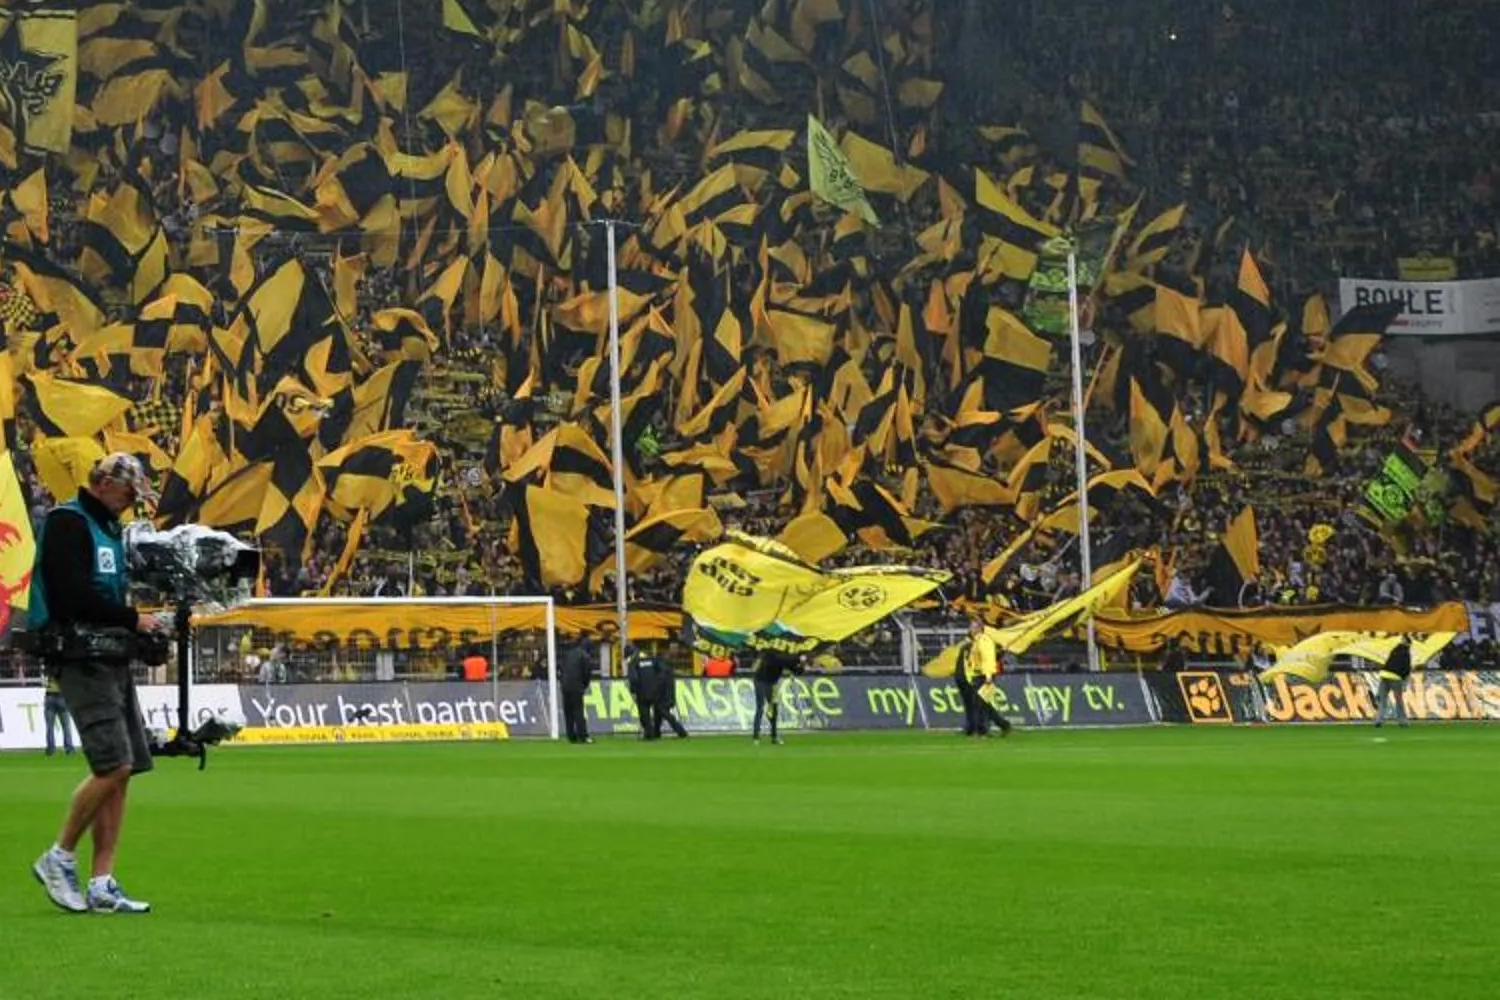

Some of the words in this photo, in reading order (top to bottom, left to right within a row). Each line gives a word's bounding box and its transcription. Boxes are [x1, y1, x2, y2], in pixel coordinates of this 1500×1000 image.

[252, 698, 327, 728] Your
[337, 694, 411, 727] best
[417, 691, 536, 724] partner.
[867, 688, 916, 725] my
[929, 684, 1019, 713] ste.
[1025, 685, 1071, 722] my
[1082, 683, 1124, 710] tv.
[1265, 671, 1378, 720] Jack
